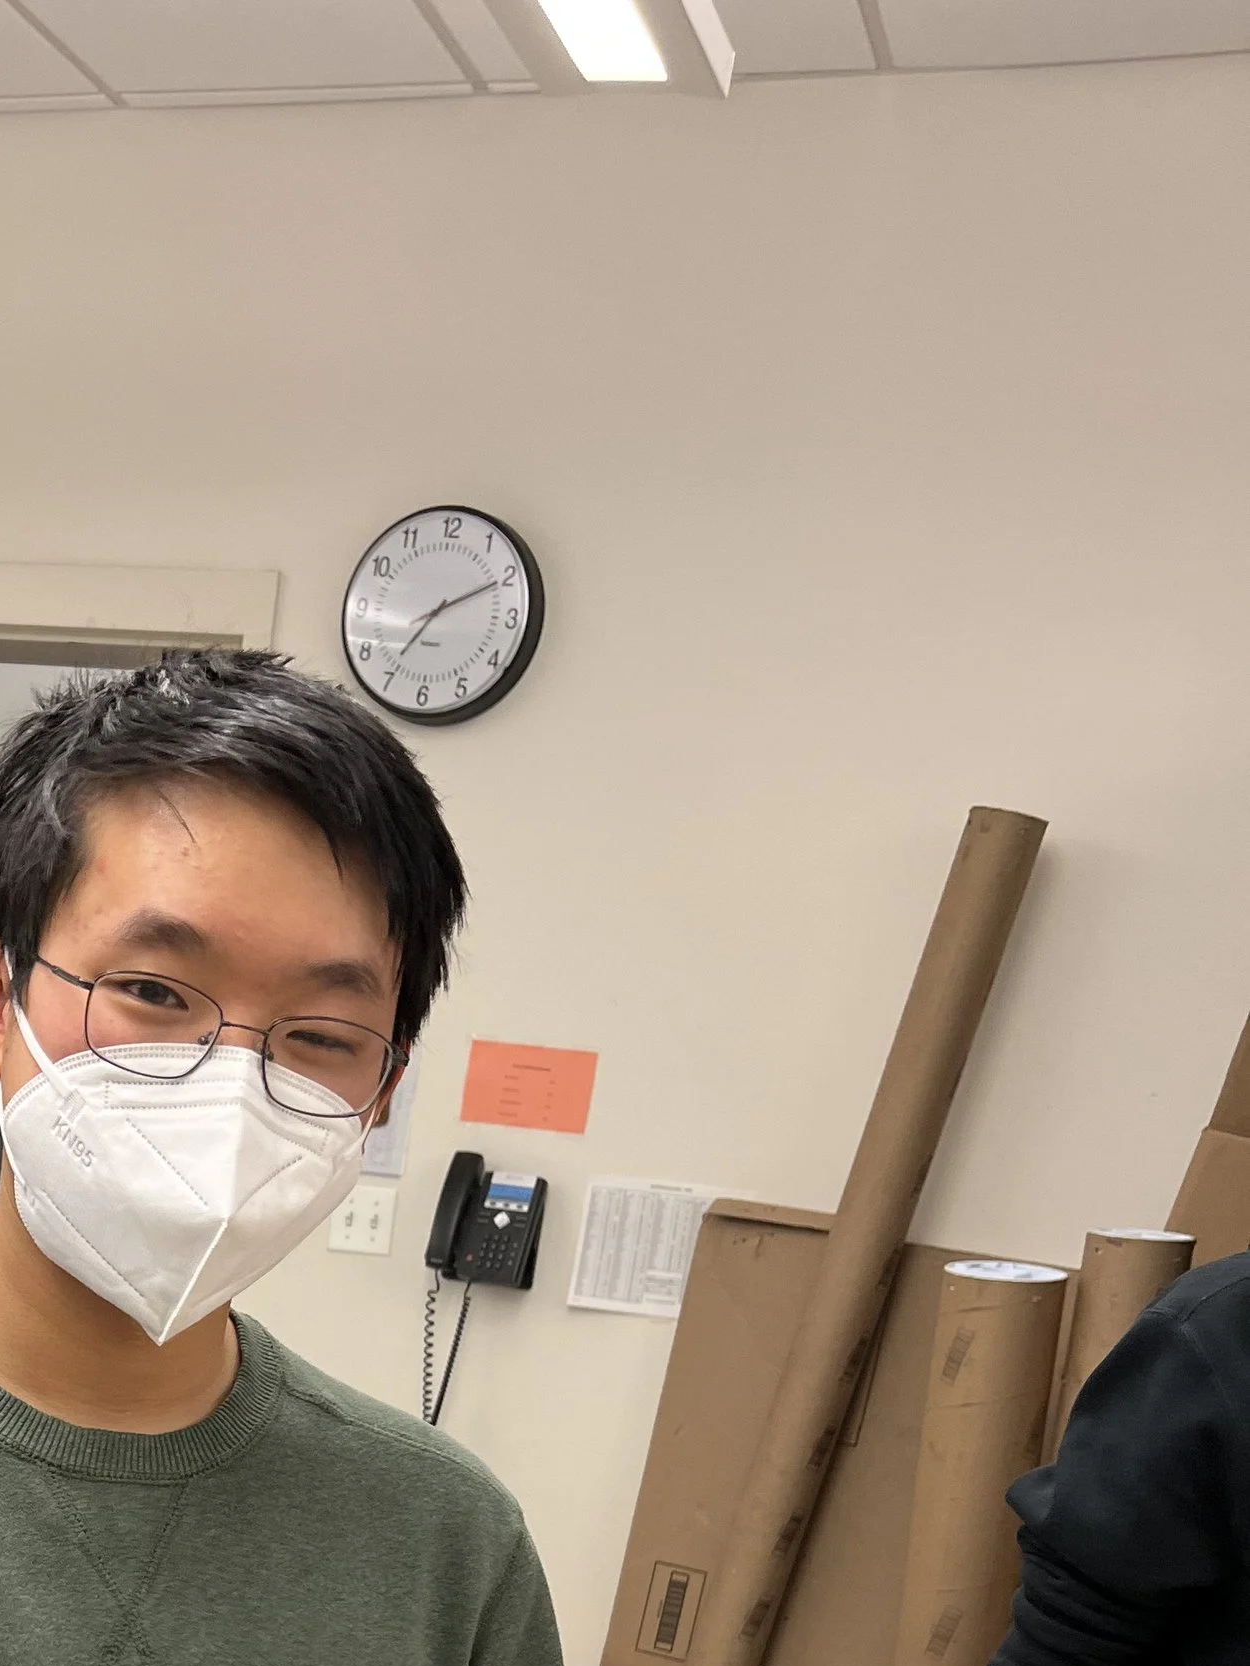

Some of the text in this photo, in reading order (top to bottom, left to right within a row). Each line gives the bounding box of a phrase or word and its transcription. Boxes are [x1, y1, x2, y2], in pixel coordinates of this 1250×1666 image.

[402, 527, 418, 548] 11
[443, 517, 462, 538] 12
[485, 532, 494, 553] 1
[372, 556, 391, 577] 10
[502, 565, 516, 587] 2
[355, 598, 368, 619] 9
[505, 608, 518, 630] 3
[359, 641, 371, 661] 8
[487, 650, 499, 668] 4
[383, 671, 395, 692] 7
[454, 677, 468, 699] 5
[416, 685, 429, 706] 6
[51, 1116, 94, 1167] KN95
